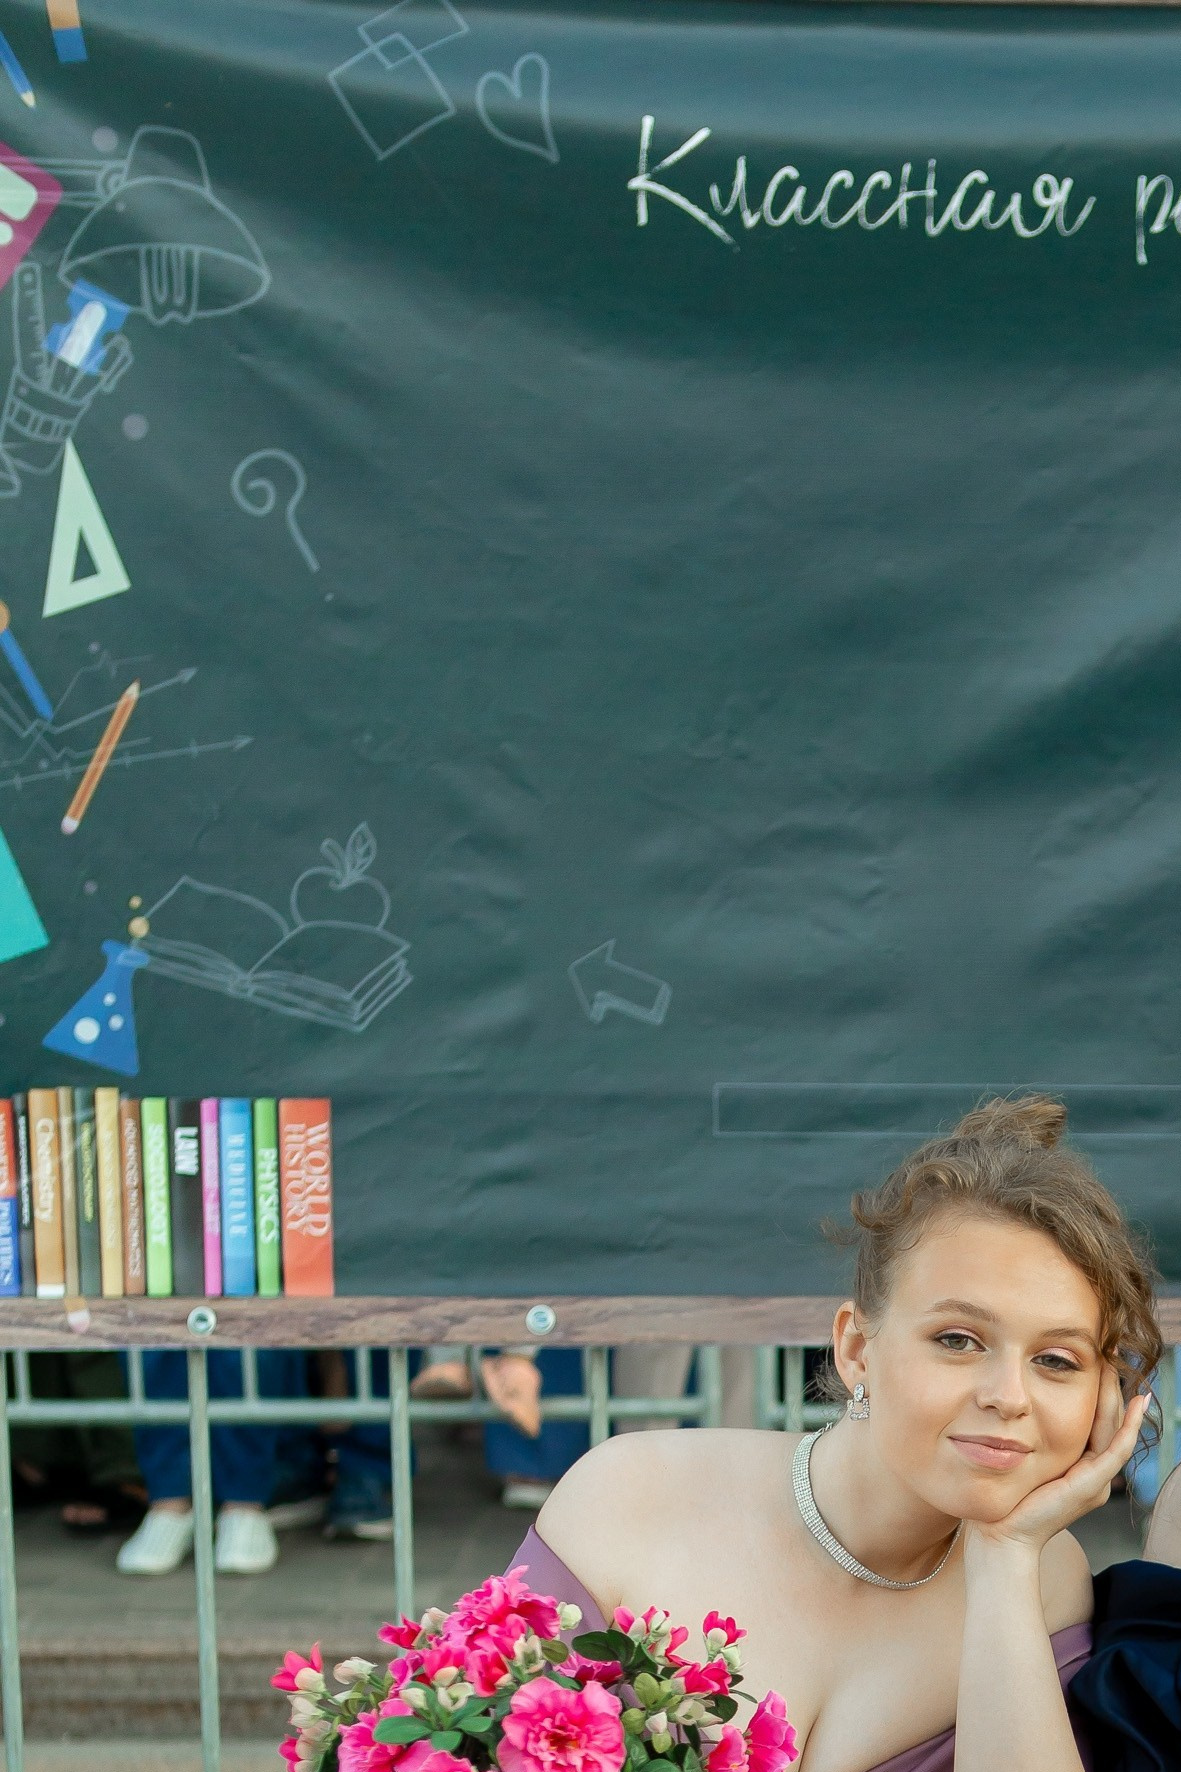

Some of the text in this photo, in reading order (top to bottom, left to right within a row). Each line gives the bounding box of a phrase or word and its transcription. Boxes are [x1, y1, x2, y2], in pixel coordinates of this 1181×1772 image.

[628, 115, 1097, 252] Классная
[174, 1126, 199, 1176] LAW
[259, 1148, 278, 1244] PHYSICS
[285, 1123, 306, 1232] HISTORY
[303, 1121, 330, 1237] WORLD
